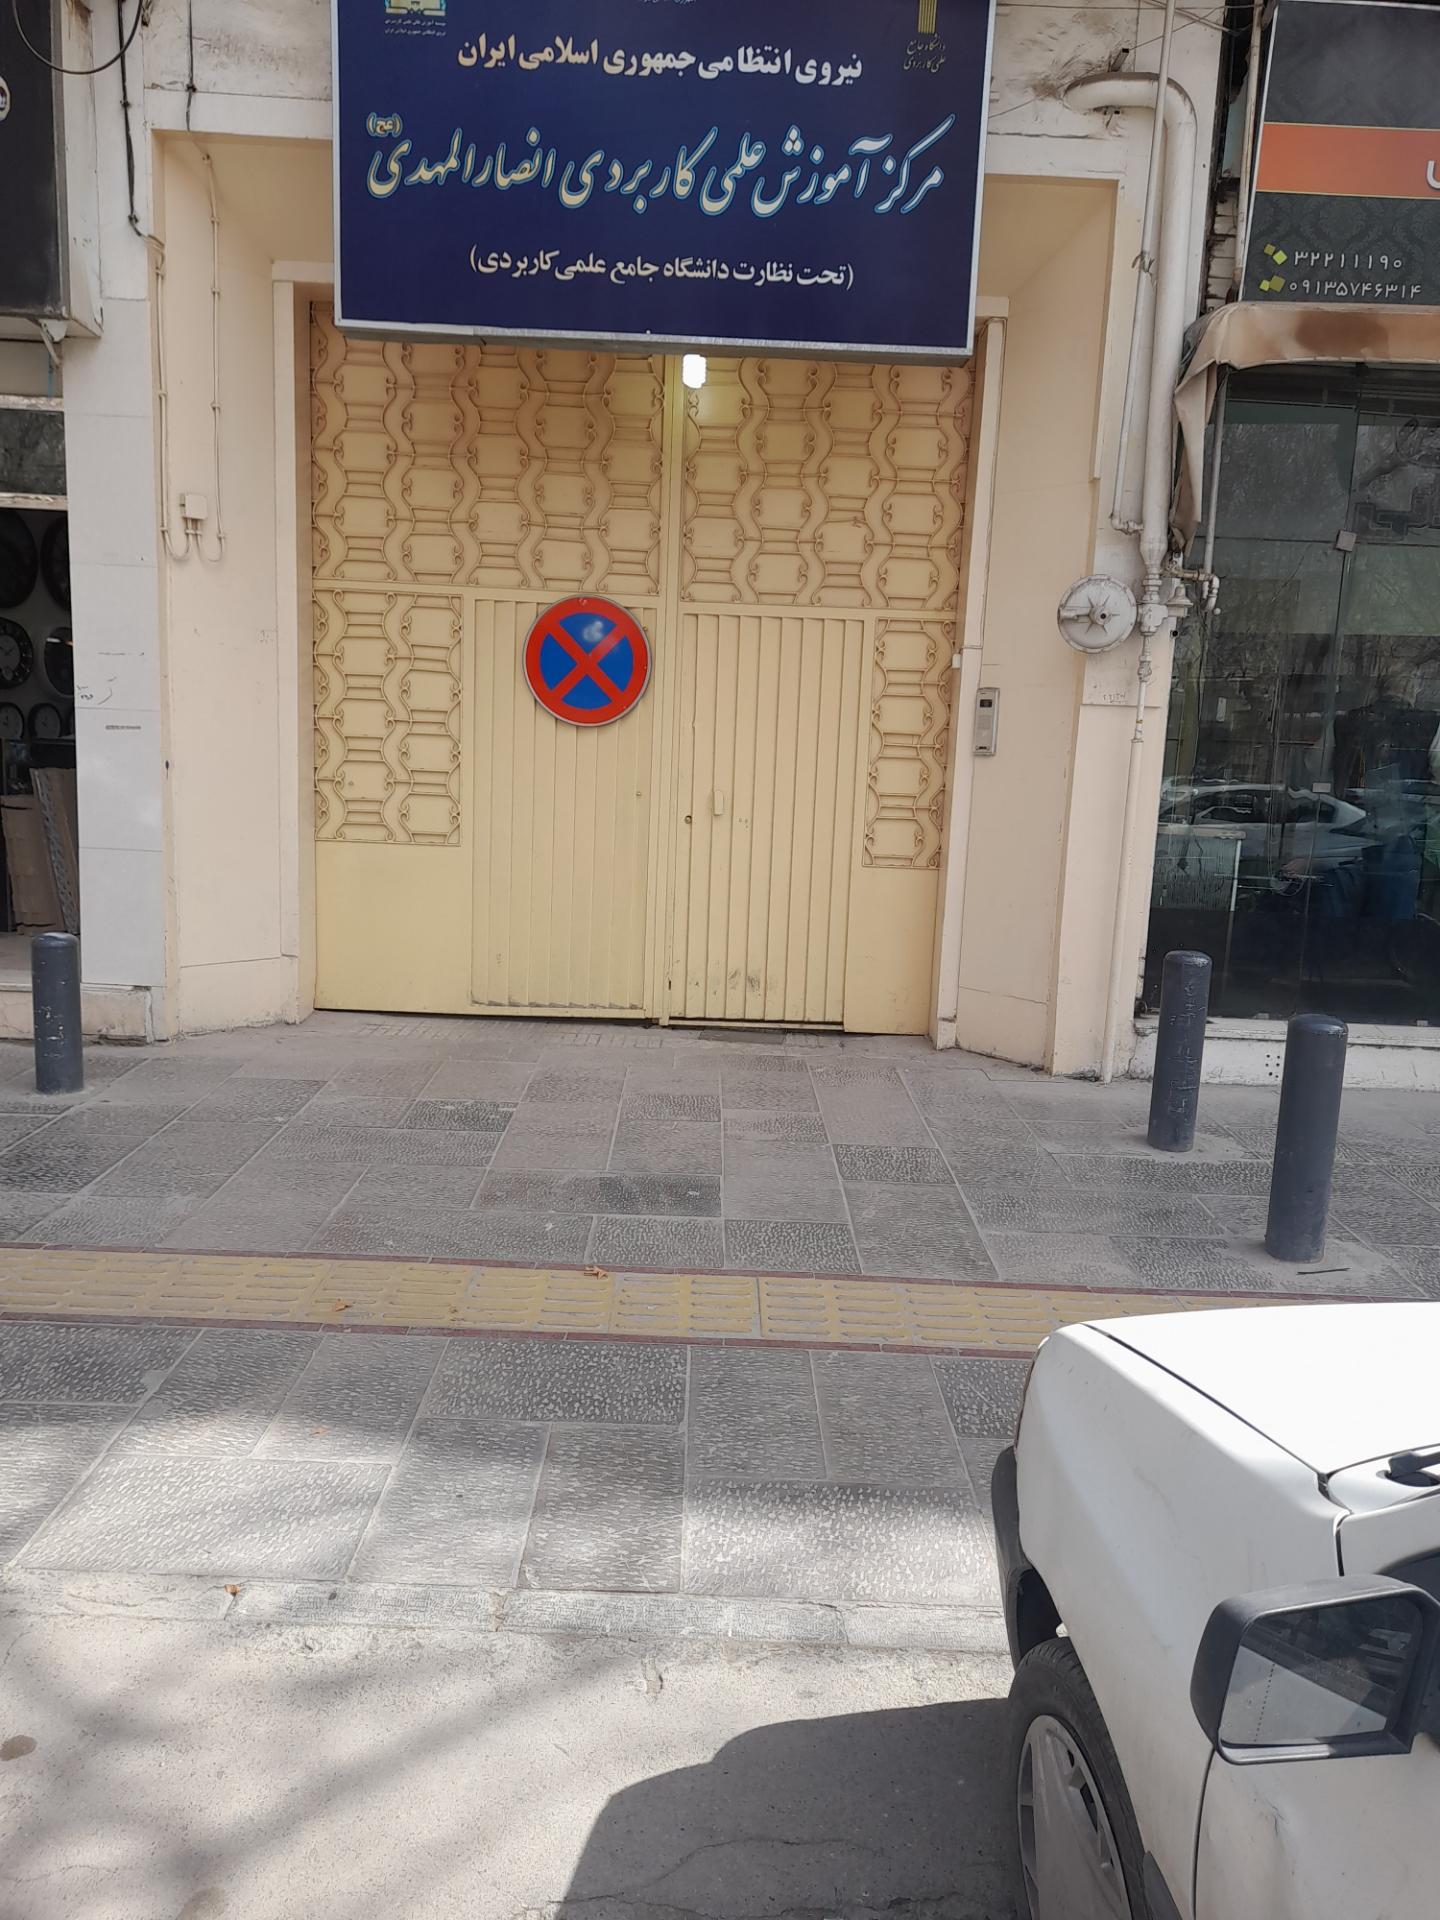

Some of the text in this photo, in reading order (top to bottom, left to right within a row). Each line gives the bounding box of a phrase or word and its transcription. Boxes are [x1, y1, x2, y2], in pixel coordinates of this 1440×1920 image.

[458, 32, 863, 86] نیروی انتظامی جمهوری اسلامی ایران
[366, 112, 955, 217] مرکز آموزش علمی کاربردی انصار المهدی (عج)
[470, 244, 854, 291] (تحت نظارت دانشگاه جامع علمی کاربردی)
[1294, 250, 1402, 271] ۳۲۲۱۱۱۹۰
[1289, 279, 1422, 299] ۰۹۱۳۵۷۴۶۳۱۴
